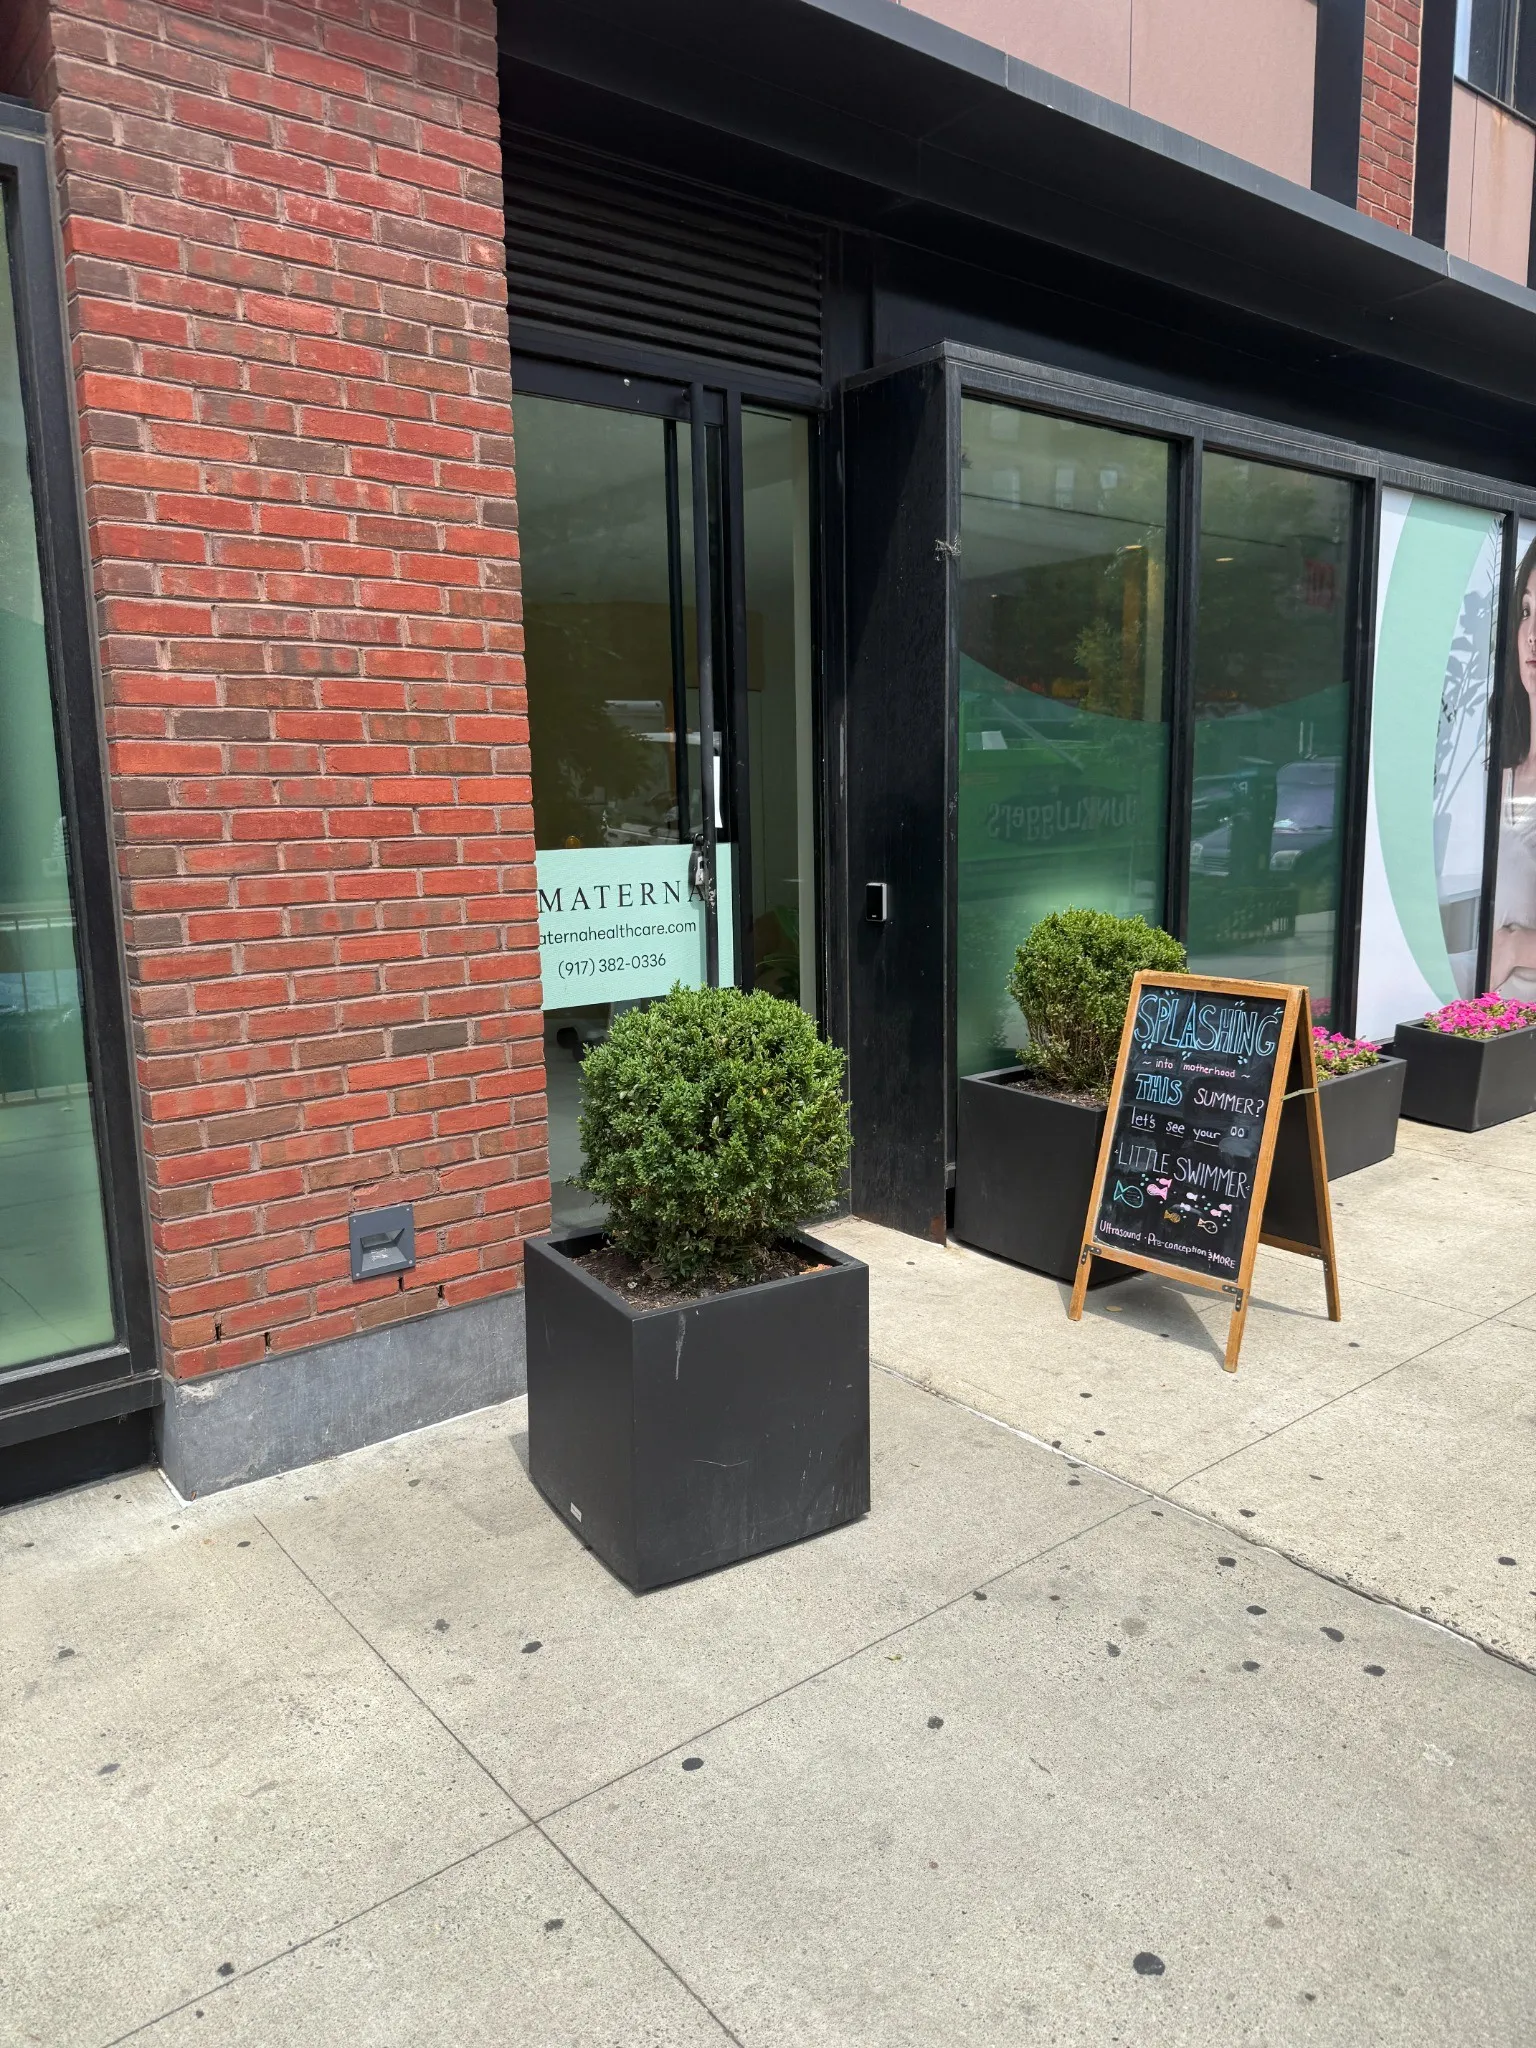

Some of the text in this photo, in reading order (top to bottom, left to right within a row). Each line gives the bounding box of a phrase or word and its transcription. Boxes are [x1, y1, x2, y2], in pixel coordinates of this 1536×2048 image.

[538, 880, 705, 913] MATERNA
[558, 953, 667, 979] (917) 382-0336
[1133, 994, 1279, 1057] SPLASHING
[1155, 1058, 1236, 1078] into motherhood
[1135, 1073, 1265, 1118] THIS SUMMER?
[1165, 1121, 1185, 1135] see
[1193, 1127, 1221, 1140] your
[1118, 1142, 1247, 1199] LITTLE SWIMMER
[1099, 1219, 1142, 1241] Ultrasound
[1147, 1232, 1207, 1257] Pre-conception
